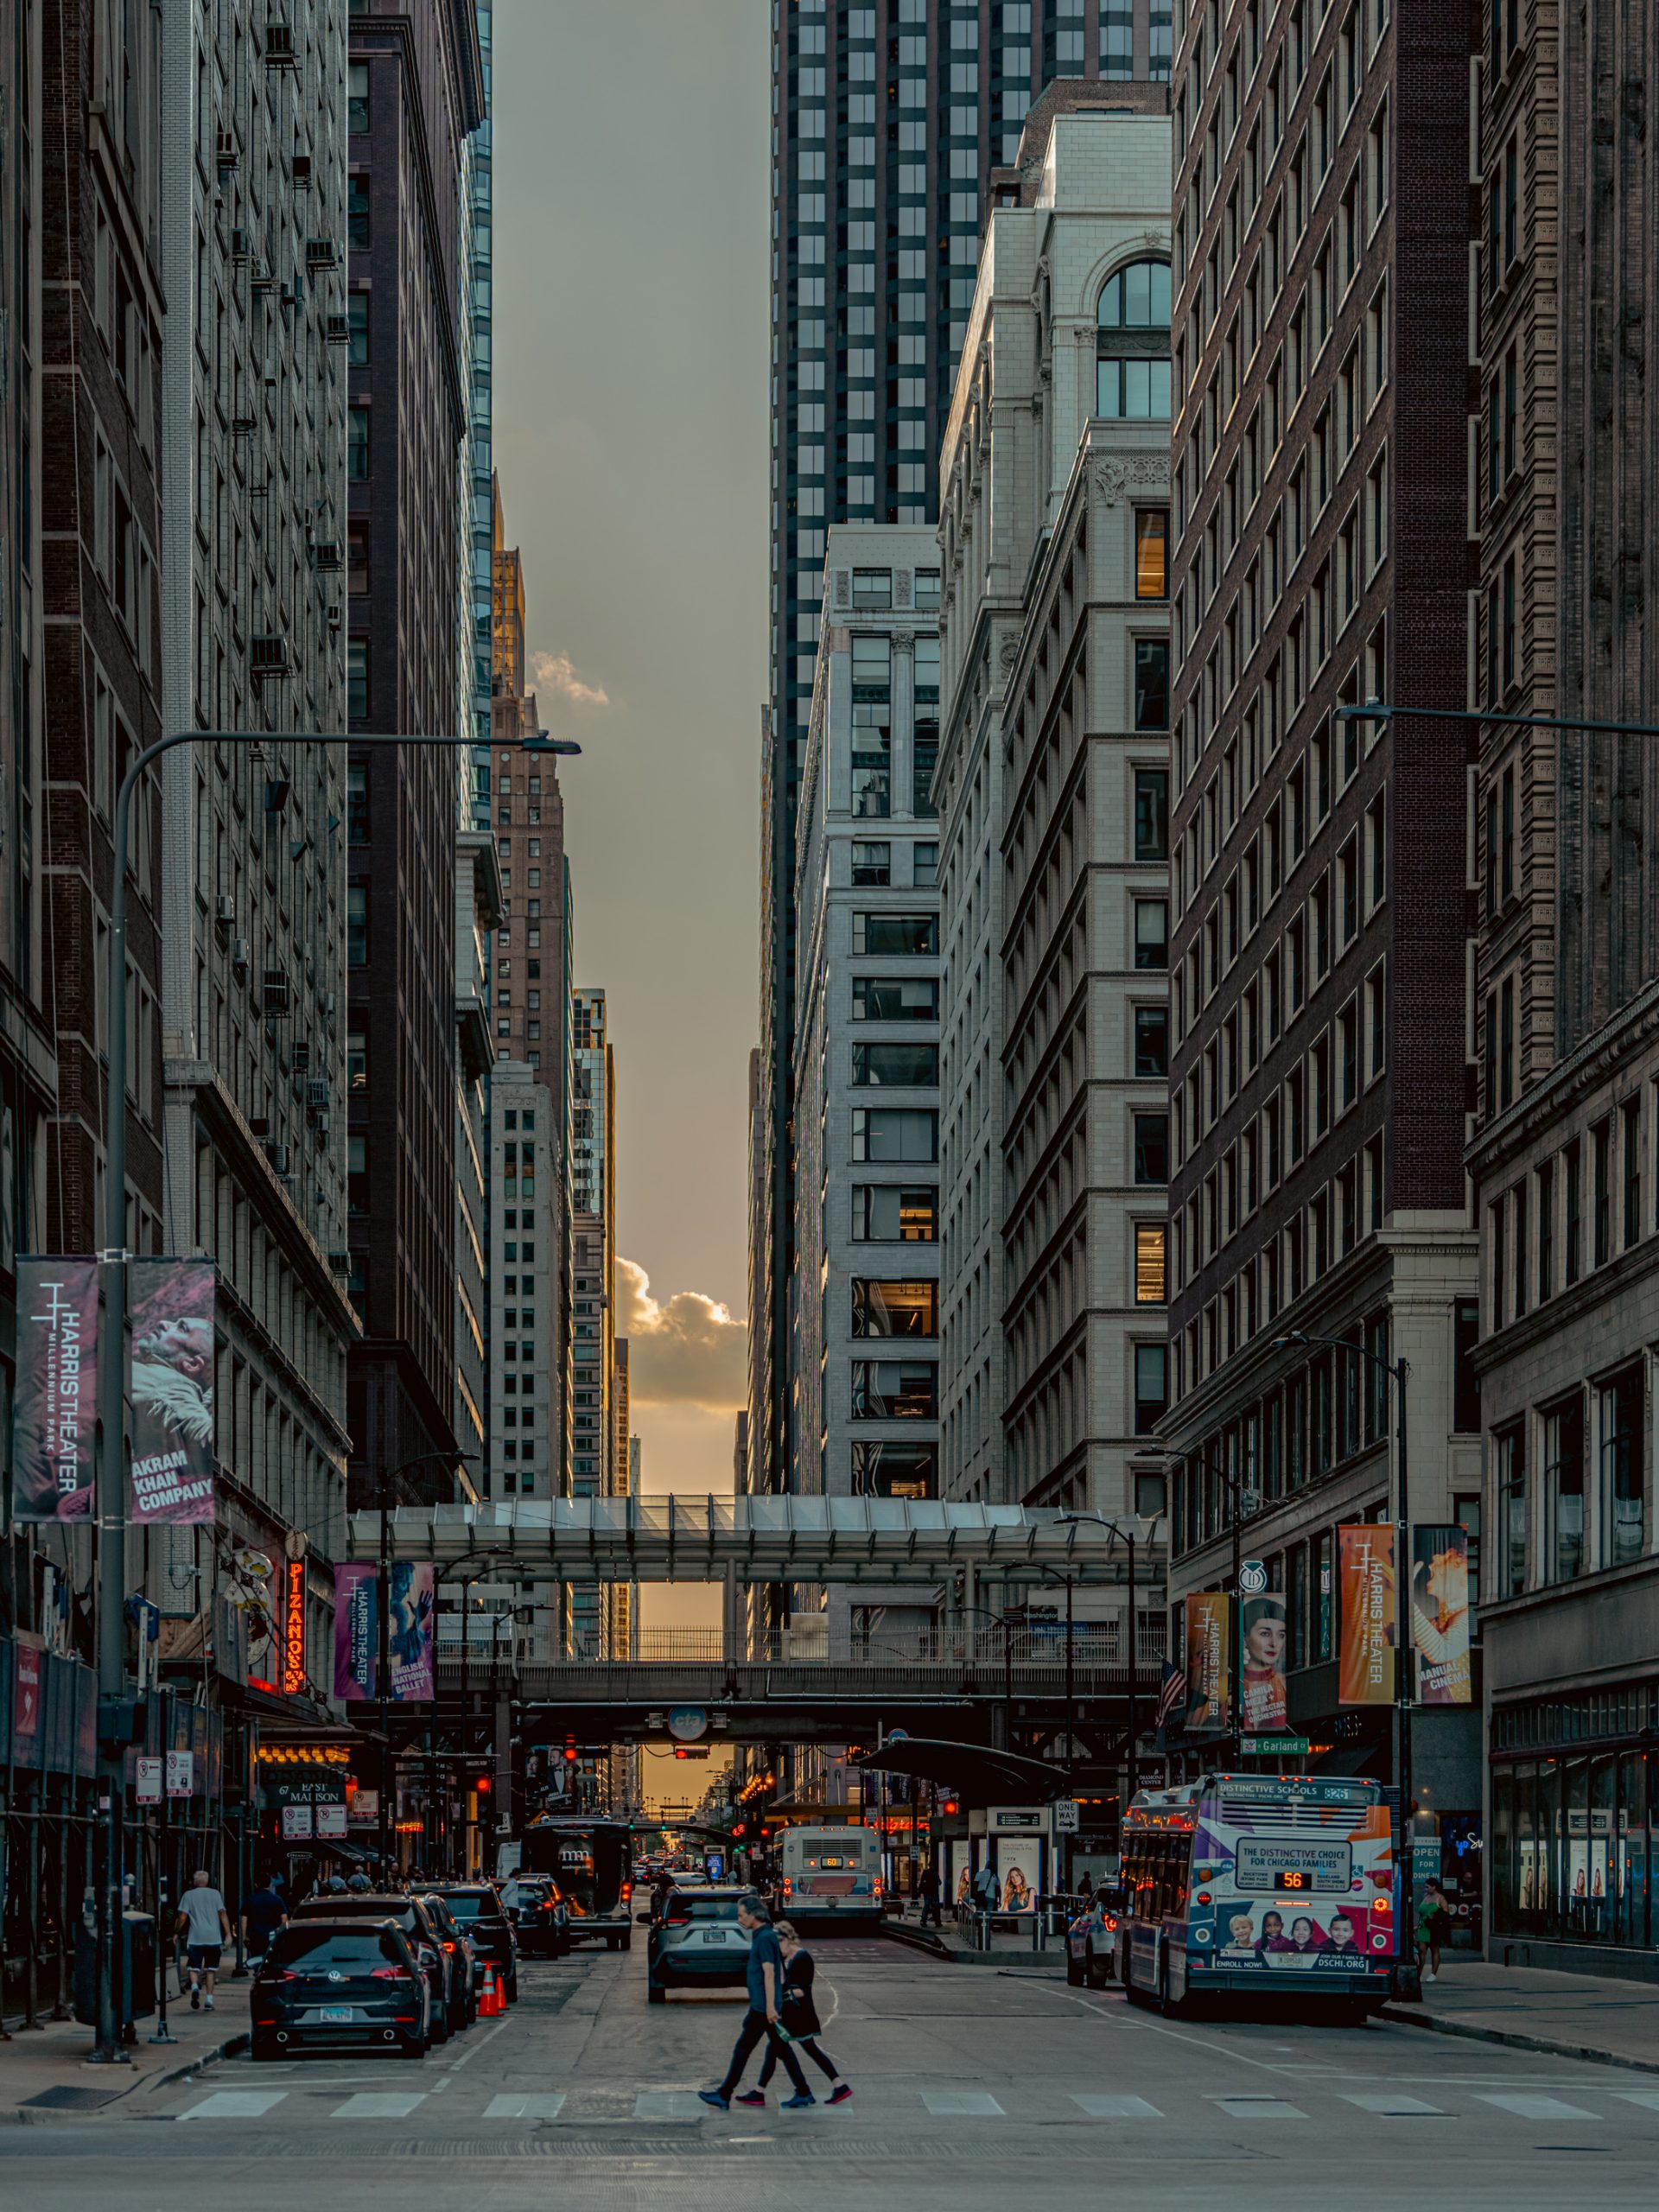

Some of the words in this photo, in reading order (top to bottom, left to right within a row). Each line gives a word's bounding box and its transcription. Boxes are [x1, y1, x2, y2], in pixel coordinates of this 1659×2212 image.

[60, 1313, 79, 1395] HARRIS
[47, 1333, 56, 1413] MILLENNIUM
[59, 1398, 79, 1492] THEATER
[131, 1450, 188, 1478] AKRAM
[133, 1471, 178, 1495] KHAN
[138, 1478, 213, 1512] COMPANY
[1370, 1563, 1382, 1619] HARRIS
[358, 1592, 368, 1635] HARRIS
[1210, 1624, 1219, 1666] HARRIS
[1370, 1620, 1382, 1683] THEATER
[357, 1637, 368, 1684] THEATER
[391, 1661, 424, 1675] ENGLISH
[393, 1669, 431, 1685] NATIONAL
[1416, 1662, 1460, 1681] MANUAL
[396, 1681, 424, 1694] BALLET
[1430, 1672, 1470, 1689] CINEMA
[1210, 1667, 1219, 1716] THEATER
[1243, 1684, 1273, 1699] CAMILA
[1245, 1695, 1268, 1707] MEZA
[1247, 1707, 1259, 1716] THE
[1260, 1701, 1285, 1714] NECTAR
[675, 1714, 701, 1726] cta
[1249, 1710, 1286, 1723] ORCHESTRA
[1263, 1740, 1298, 1751] Garland
[279, 1786, 289, 1796] 67
[1220, 1783, 1274, 1794] DISTINCTIVE
[1277, 1786, 1318, 1795] SCHOLS
[1325, 1788, 1351, 1799] 8261
[1260, 1848, 1316, 1858] DISTINCTIVE
[1413, 1848, 1440, 1857] OPEN
[827, 1858, 837, 1866] 60
[1268, 1859, 1300, 1867] CHICAGO
[1302, 1859, 1337, 1868] FAMILIES
[1283, 1872, 1303, 1888] 56
[1217, 1960, 1243, 1968] ENROLL
[1319, 1959, 1364, 1969] DSCHI.ORG
